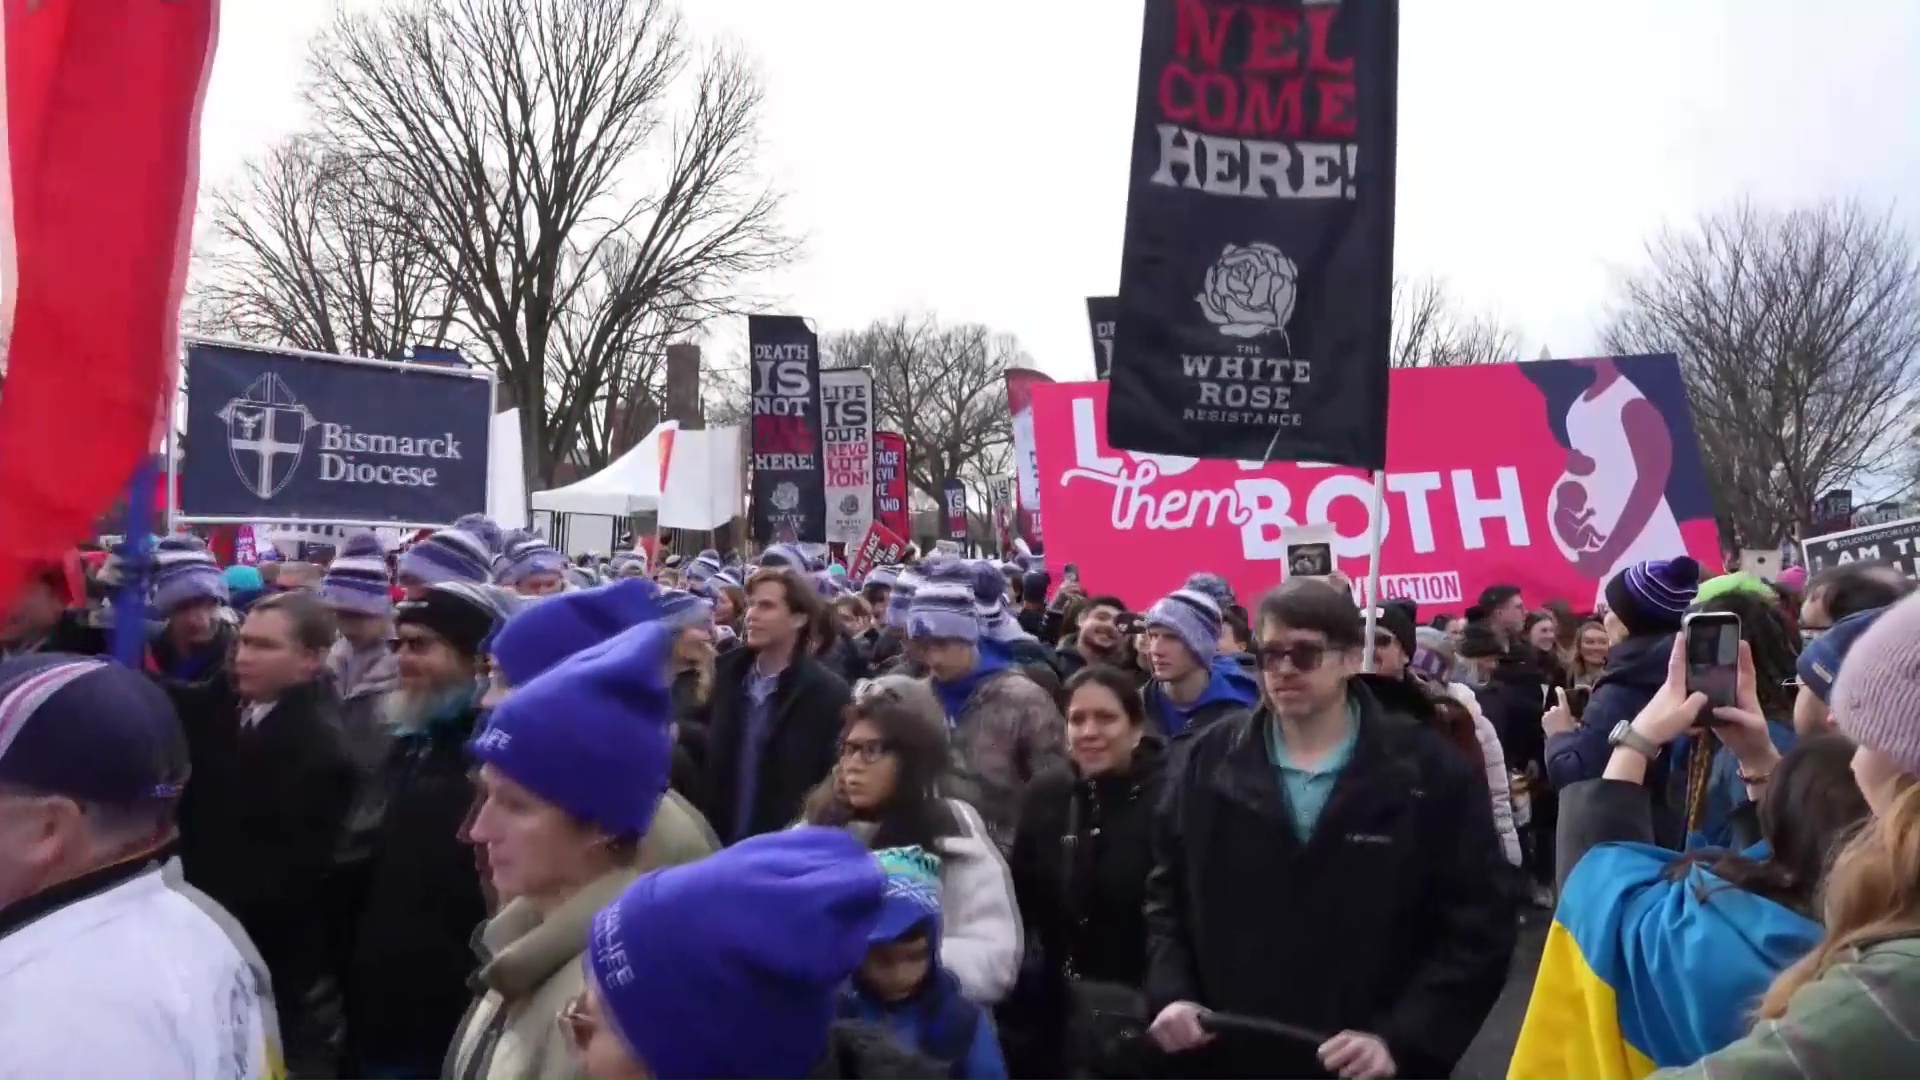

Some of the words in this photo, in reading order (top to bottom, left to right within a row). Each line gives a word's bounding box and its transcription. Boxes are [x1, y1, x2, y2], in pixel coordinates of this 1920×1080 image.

[1157, 62, 1359, 137] COME
[1149, 123, 1359, 200] HERE!
[754, 344, 809, 360] DEATH
[1235, 344, 1262, 354] THE
[754, 360, 810, 397] IS
[1179, 353, 1311, 383] WHITE
[822, 385, 866, 400] LIFE
[1198, 382, 1292, 409] ROSE
[752, 397, 810, 416] NOT
[823, 400, 868, 428] IS
[1182, 408, 1302, 426] RESISTANCE
[319, 422, 463, 459] Bismarck
[824, 427, 867, 442] OUR
[318, 453, 439, 487] Diocese
[754, 452, 815, 470] HERE!
[826, 470, 870, 488] ION!
[1059, 459, 1252, 530] them
[1233, 466, 1530, 561] BOTH
[1837, 544, 1881, 568] AM
[1386, 574, 1459, 602] ACTION
